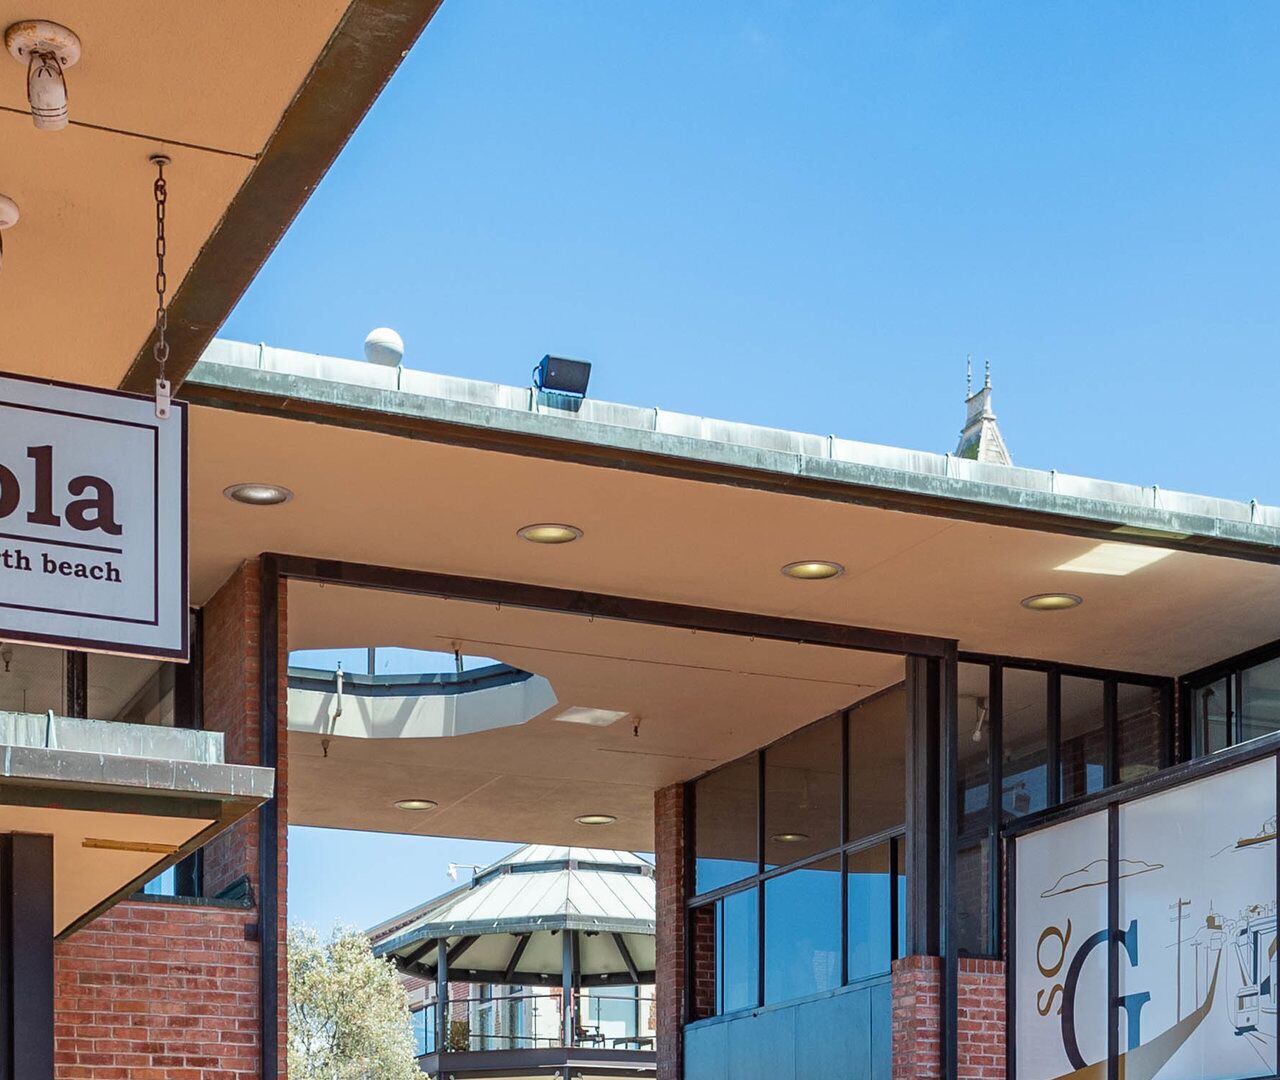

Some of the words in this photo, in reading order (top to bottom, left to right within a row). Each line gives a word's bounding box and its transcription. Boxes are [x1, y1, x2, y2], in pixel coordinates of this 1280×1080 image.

[42, 553, 122, 582] beach
[1036, 918, 1072, 1016] SQ
[1061, 919, 1151, 1071] G
